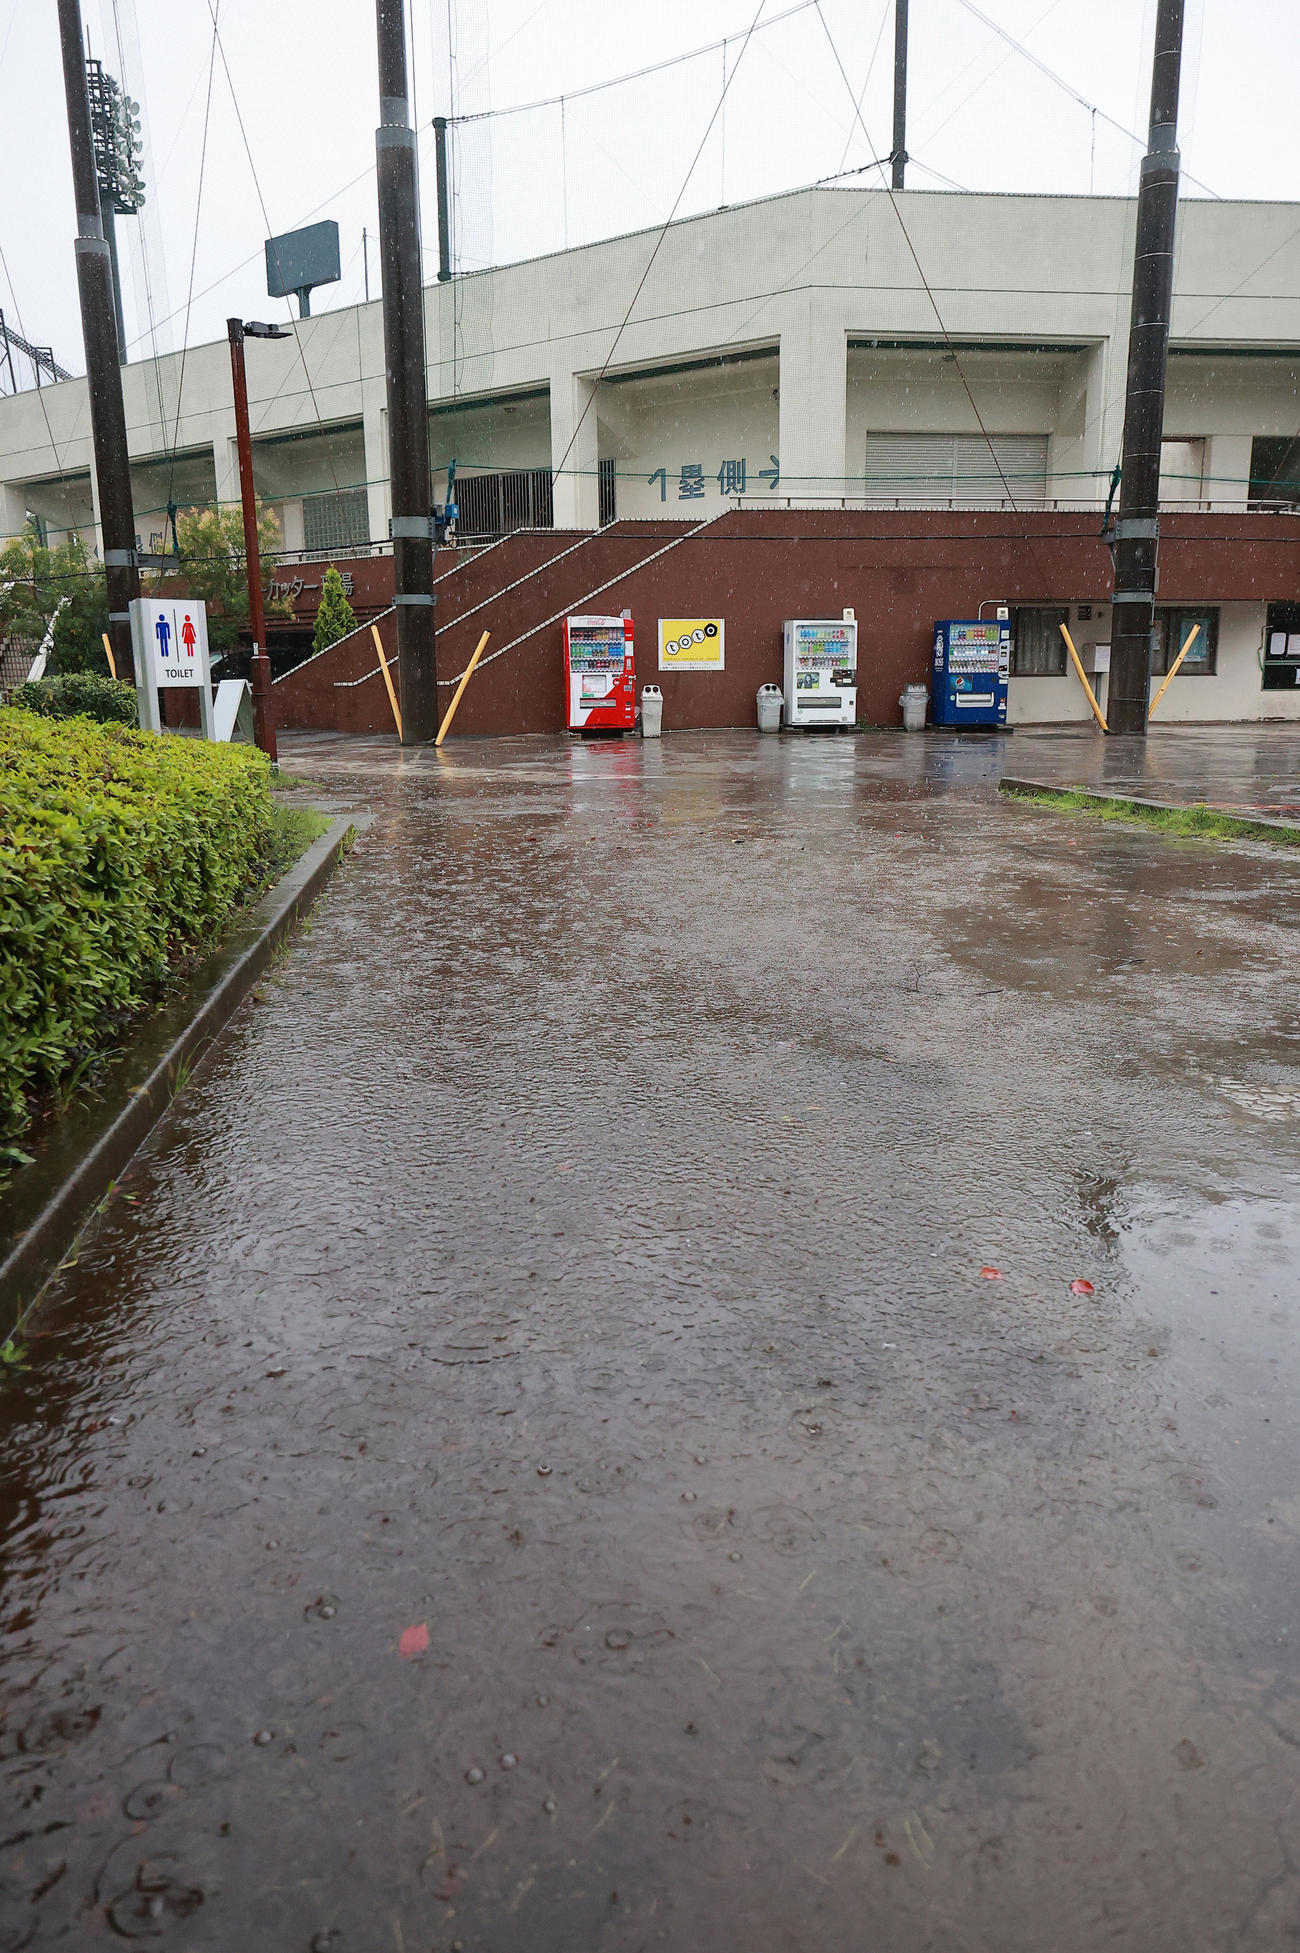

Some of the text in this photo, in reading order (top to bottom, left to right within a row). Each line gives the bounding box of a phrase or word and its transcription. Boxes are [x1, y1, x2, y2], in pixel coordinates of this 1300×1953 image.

[647, 458, 747, 502] 1塁側
[666, 623, 717, 654] toto
[165, 668, 194, 679] TOILET
